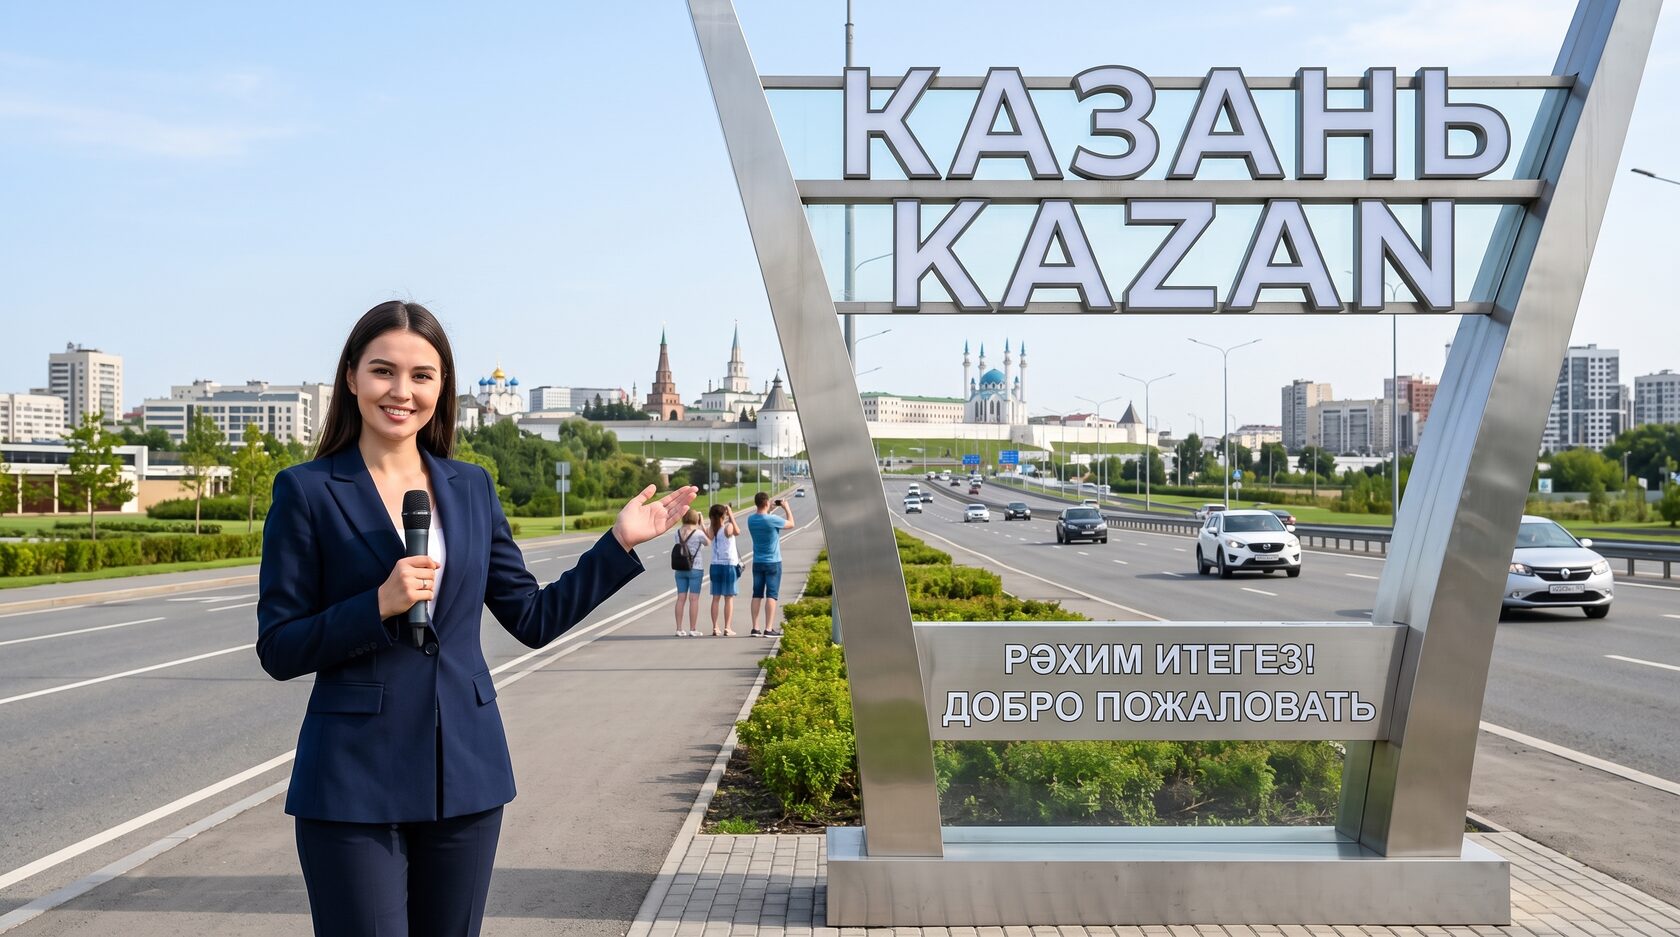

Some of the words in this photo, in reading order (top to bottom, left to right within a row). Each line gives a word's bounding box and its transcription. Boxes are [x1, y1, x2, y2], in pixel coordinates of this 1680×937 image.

[843, 65, 1511, 180] КАЗАНЬ
[893, 198, 1455, 312] KAZAN
[1004, 643, 1143, 675] РӘХИМ
[1155, 643, 1315, 675] ИТЕГЕЗ!
[942, 690, 1084, 727] ДОБРО
[1096, 690, 1376, 722] ПОЖАЛОВАТЬ
